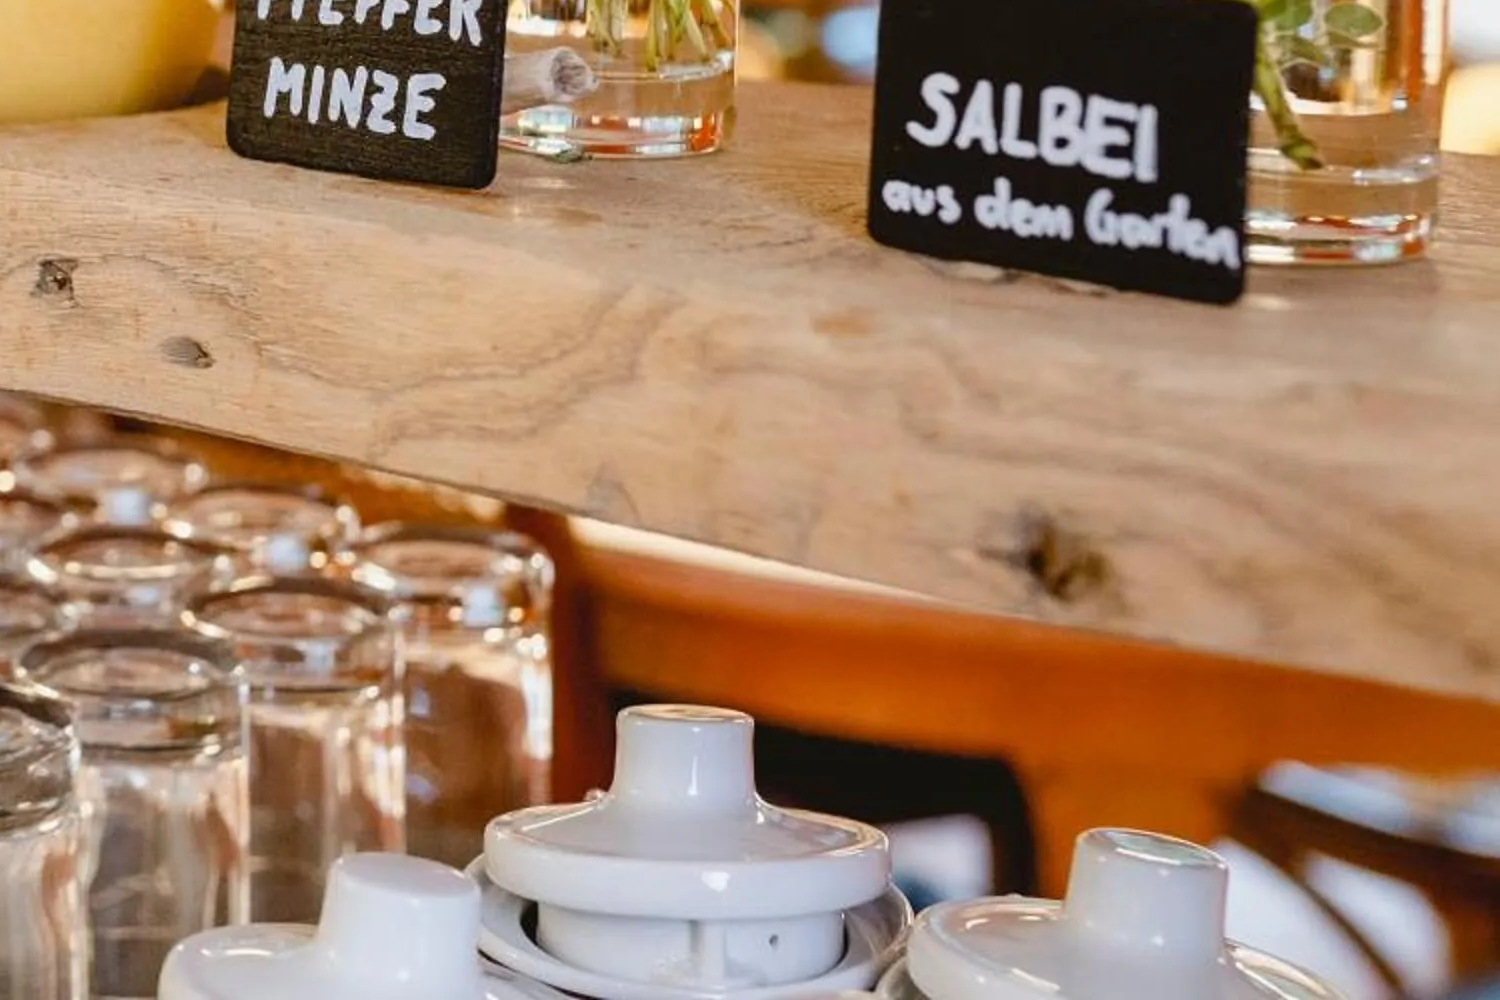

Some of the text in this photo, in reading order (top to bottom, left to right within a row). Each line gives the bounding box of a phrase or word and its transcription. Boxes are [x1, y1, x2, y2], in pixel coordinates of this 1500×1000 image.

[263, 56, 447, 141] MINZE
[905, 72, 1159, 183] SALBEI
[881, 176, 1241, 270] aus dem Garten
